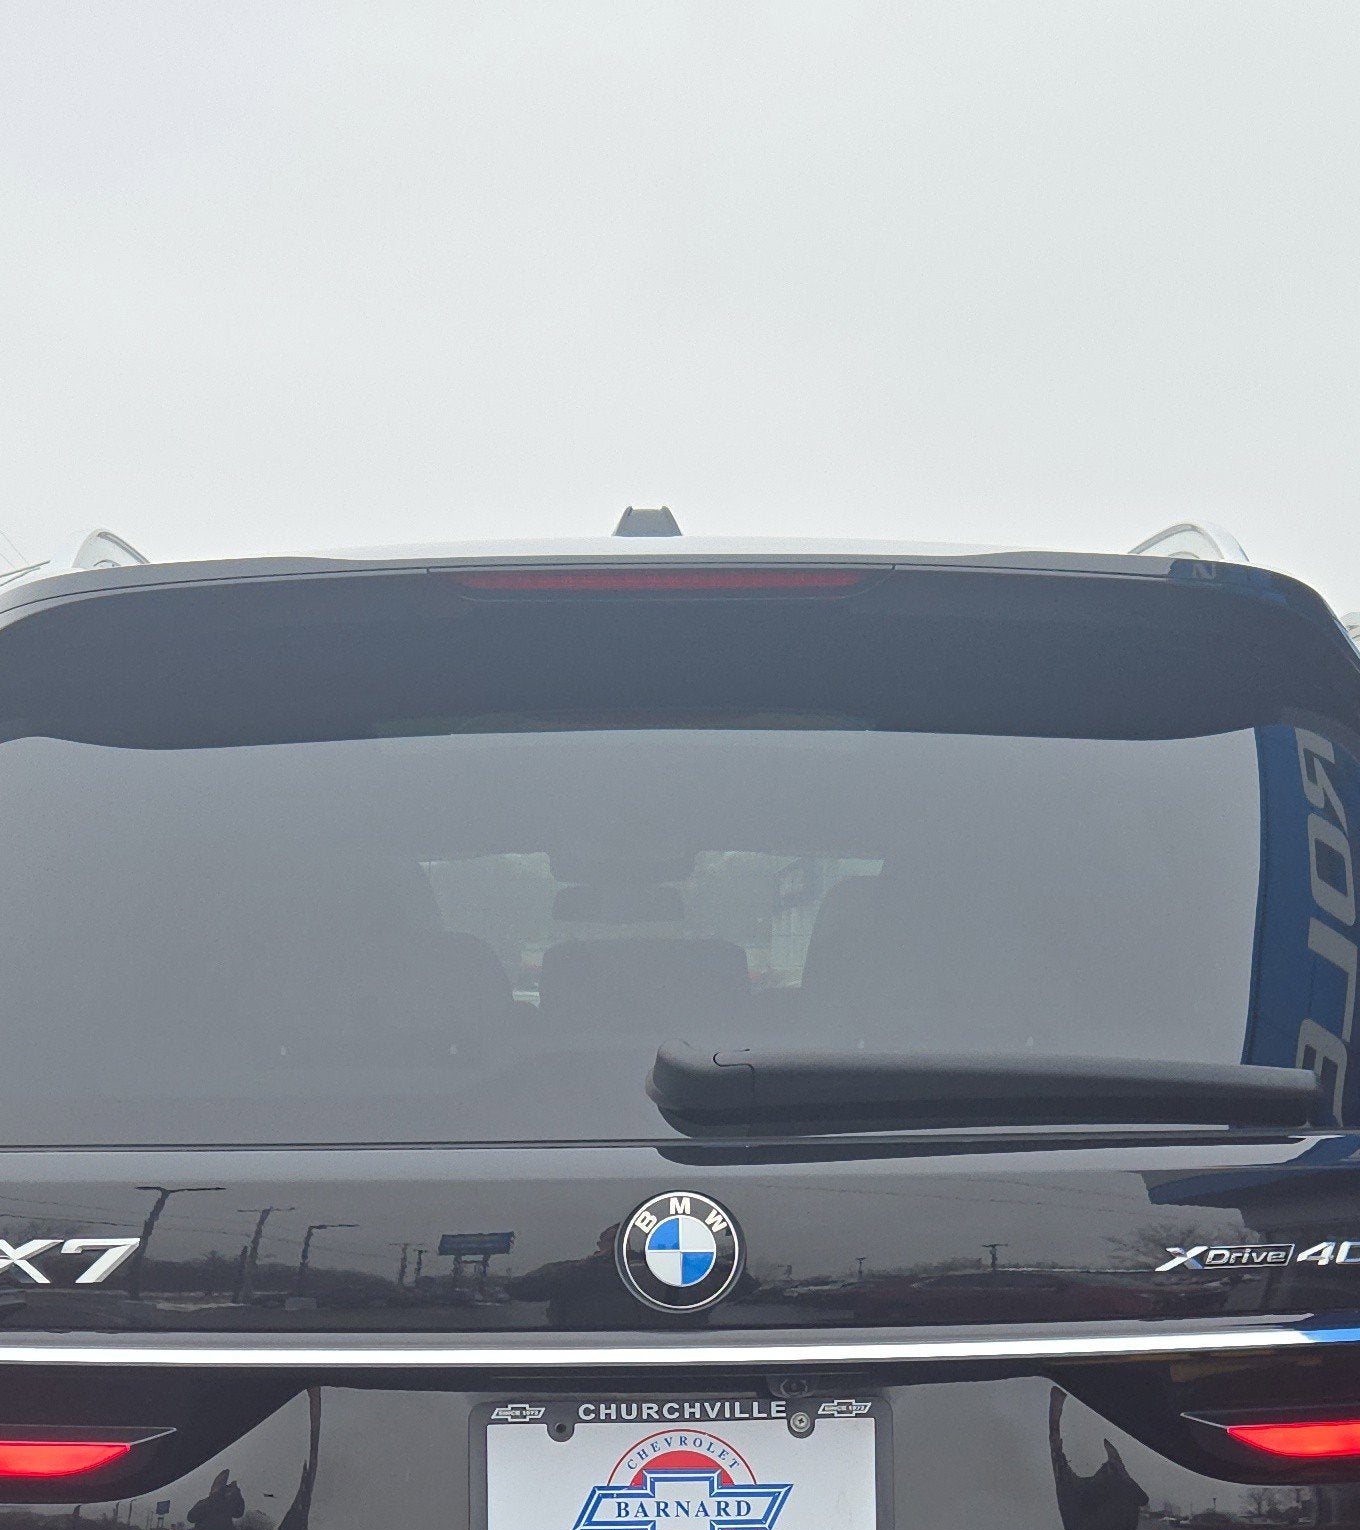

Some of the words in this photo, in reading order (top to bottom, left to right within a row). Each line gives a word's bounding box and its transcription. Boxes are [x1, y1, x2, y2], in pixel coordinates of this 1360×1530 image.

[634, 1196, 728, 1234] BMW
[578, 1401, 788, 1421] CHURCHVILLE
[626, 1435, 741, 1471] CHEVROLET
[615, 1500, 753, 1519] BARNARD
